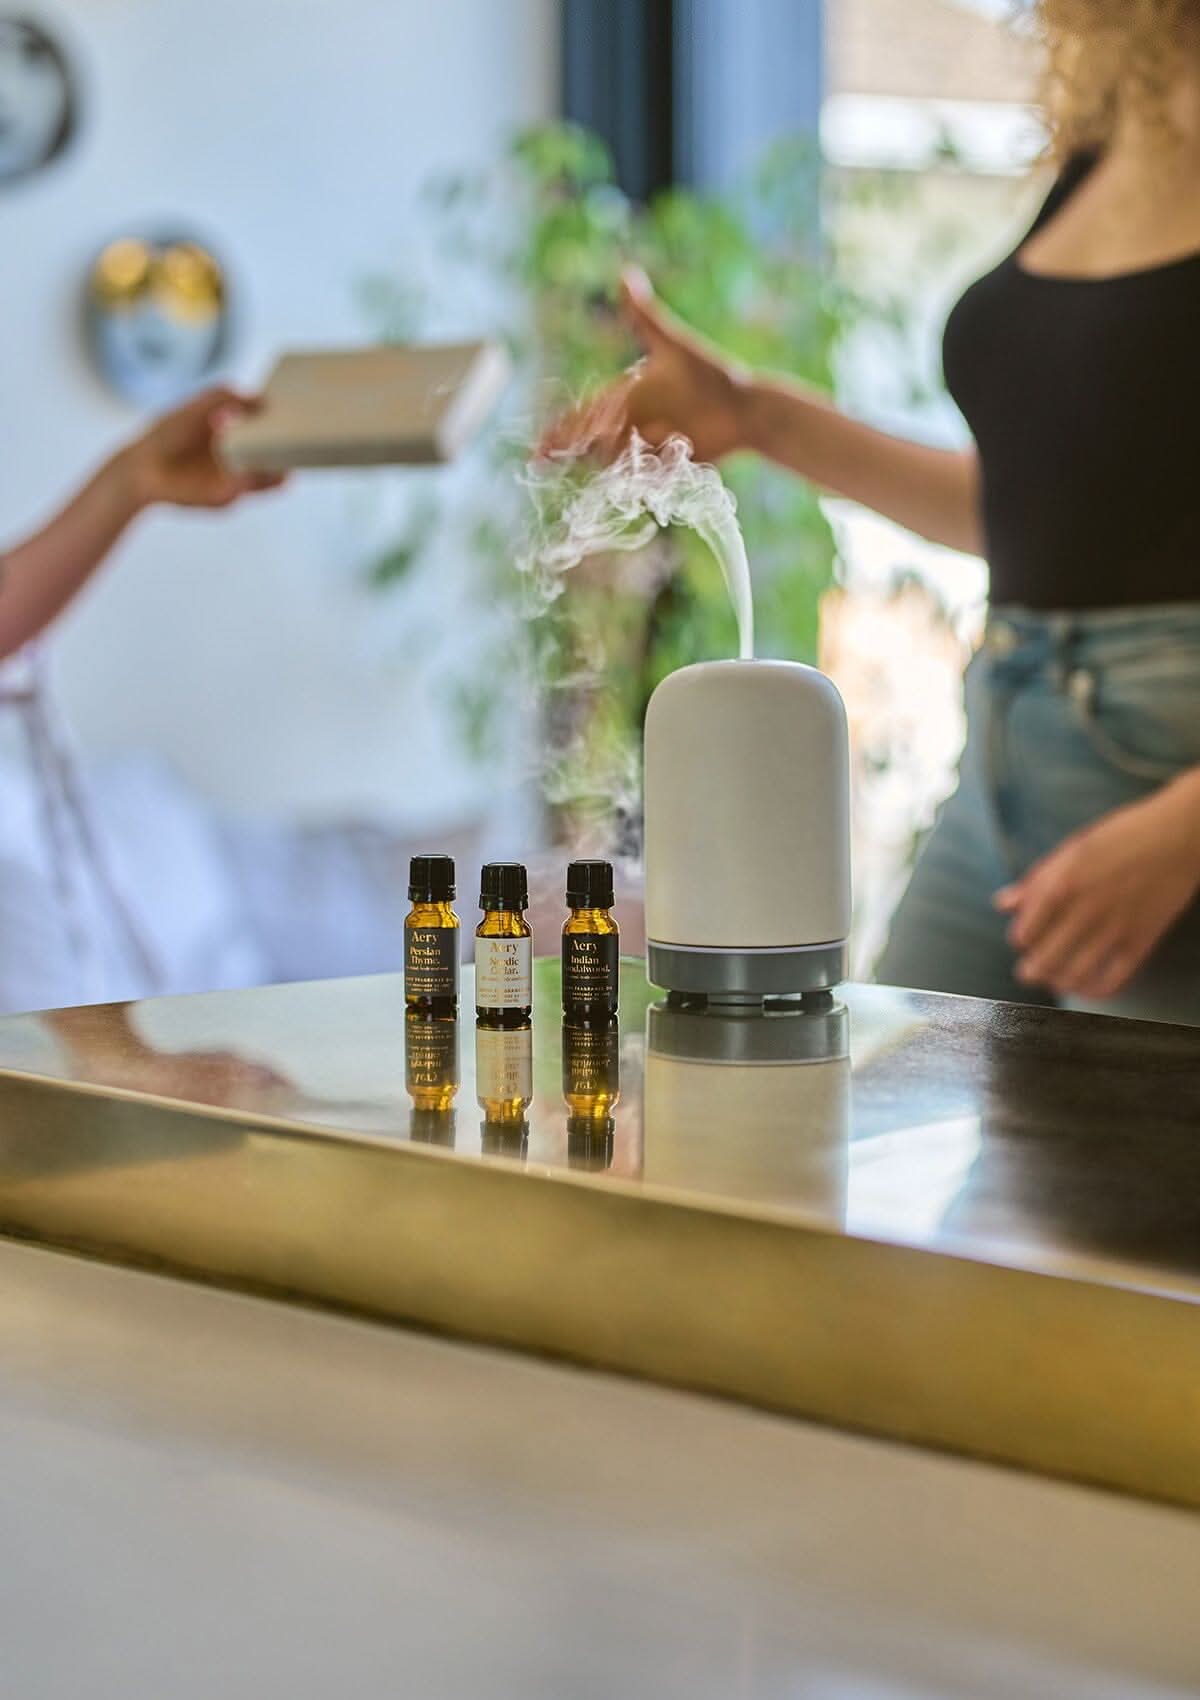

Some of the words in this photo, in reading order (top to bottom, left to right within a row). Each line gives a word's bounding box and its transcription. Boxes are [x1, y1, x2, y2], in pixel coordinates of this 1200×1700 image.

[411, 930, 439, 945] Aery
[409, 946, 441, 955] Persian
[571, 955, 599, 964] Indian
